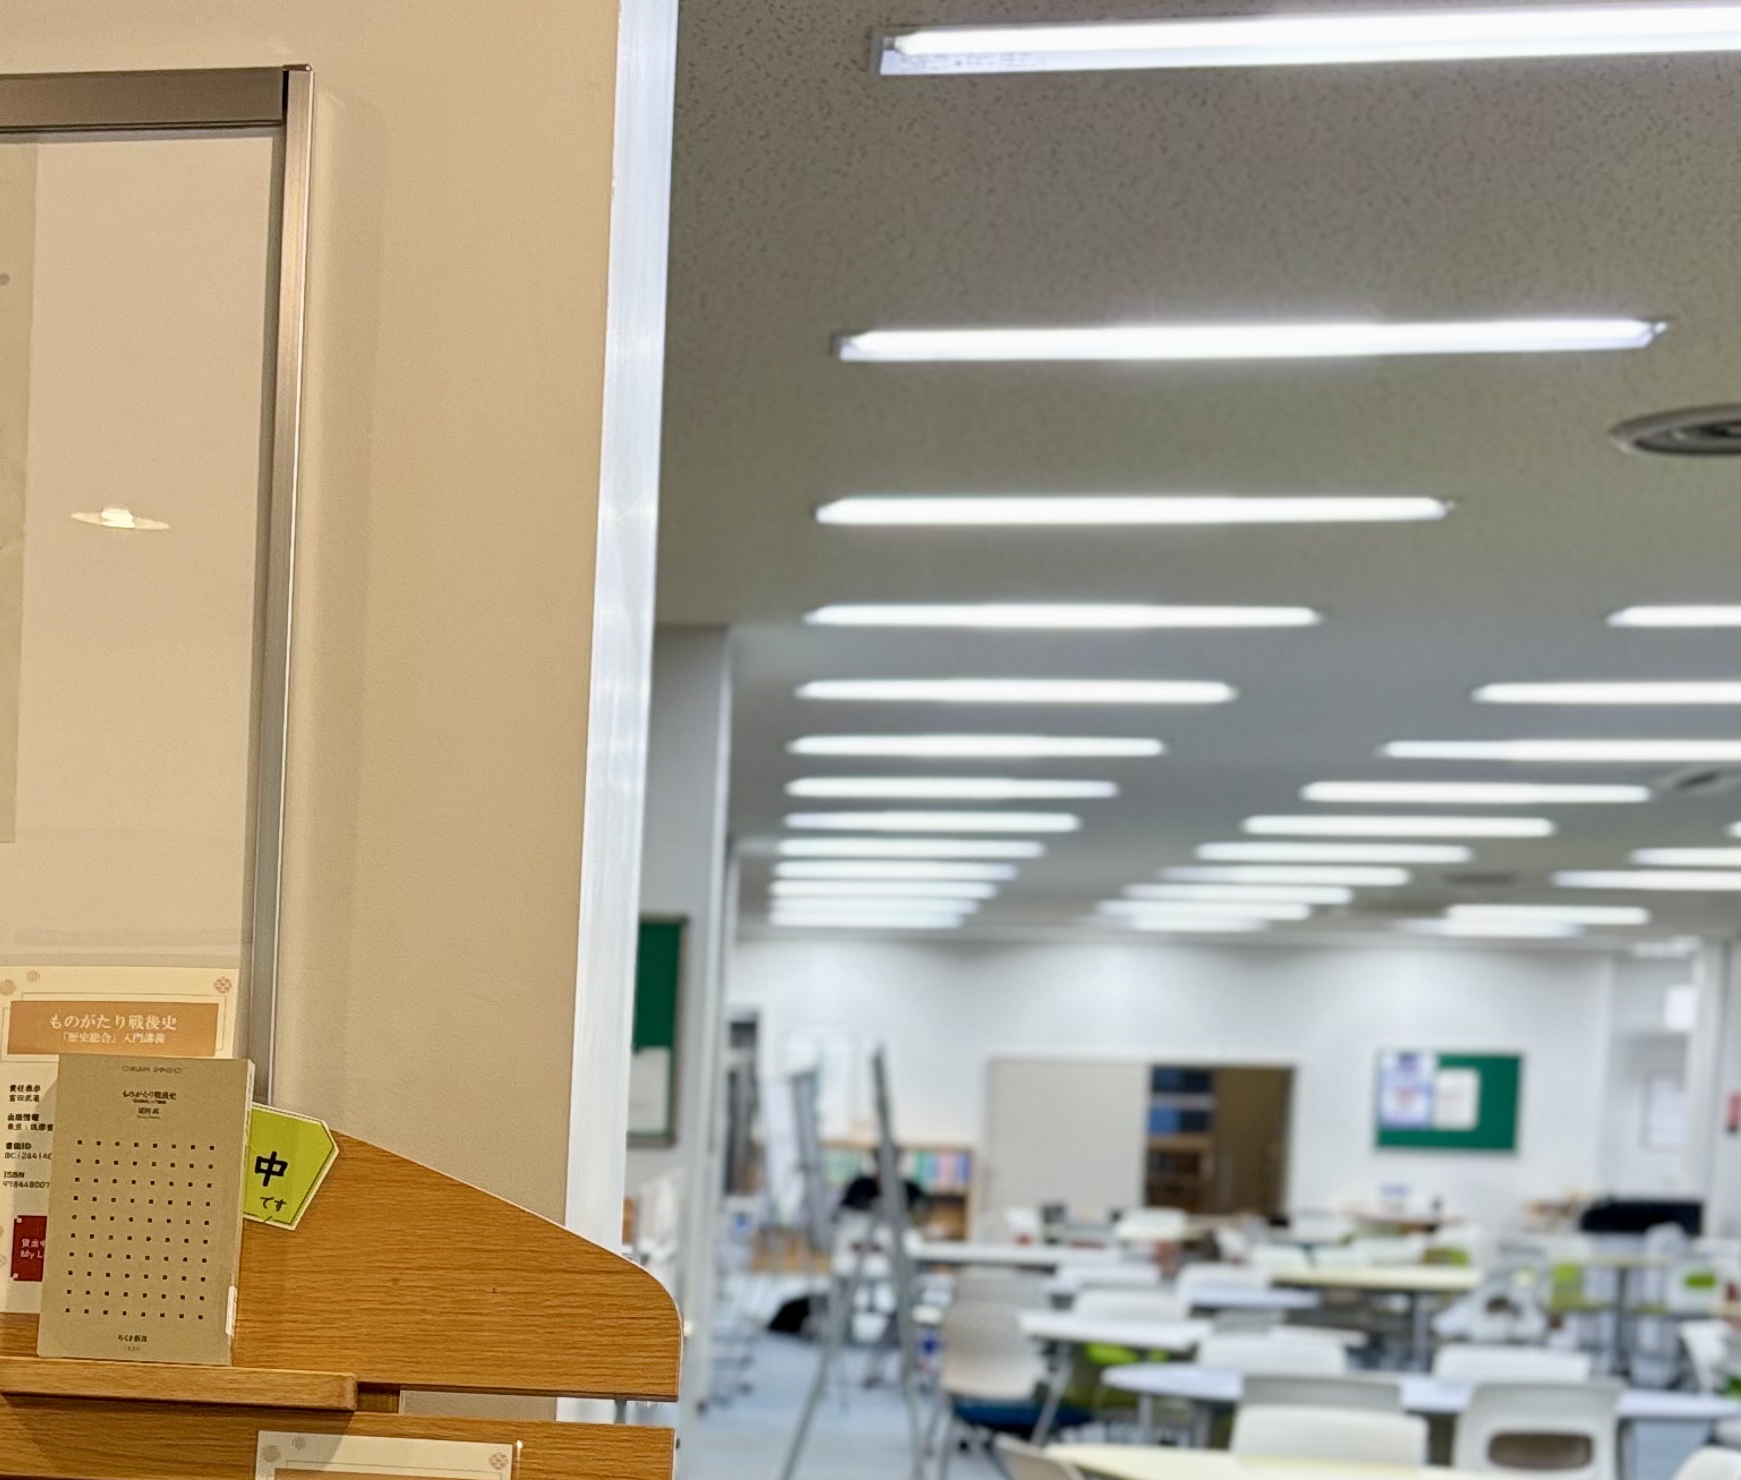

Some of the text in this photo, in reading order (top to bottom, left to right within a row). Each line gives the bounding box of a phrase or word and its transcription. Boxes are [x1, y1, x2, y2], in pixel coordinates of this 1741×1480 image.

[49, 1014, 178, 1032] ものがたり戦後史
[254, 1150, 289, 1188] 中
[259, 1194, 288, 1214] です
